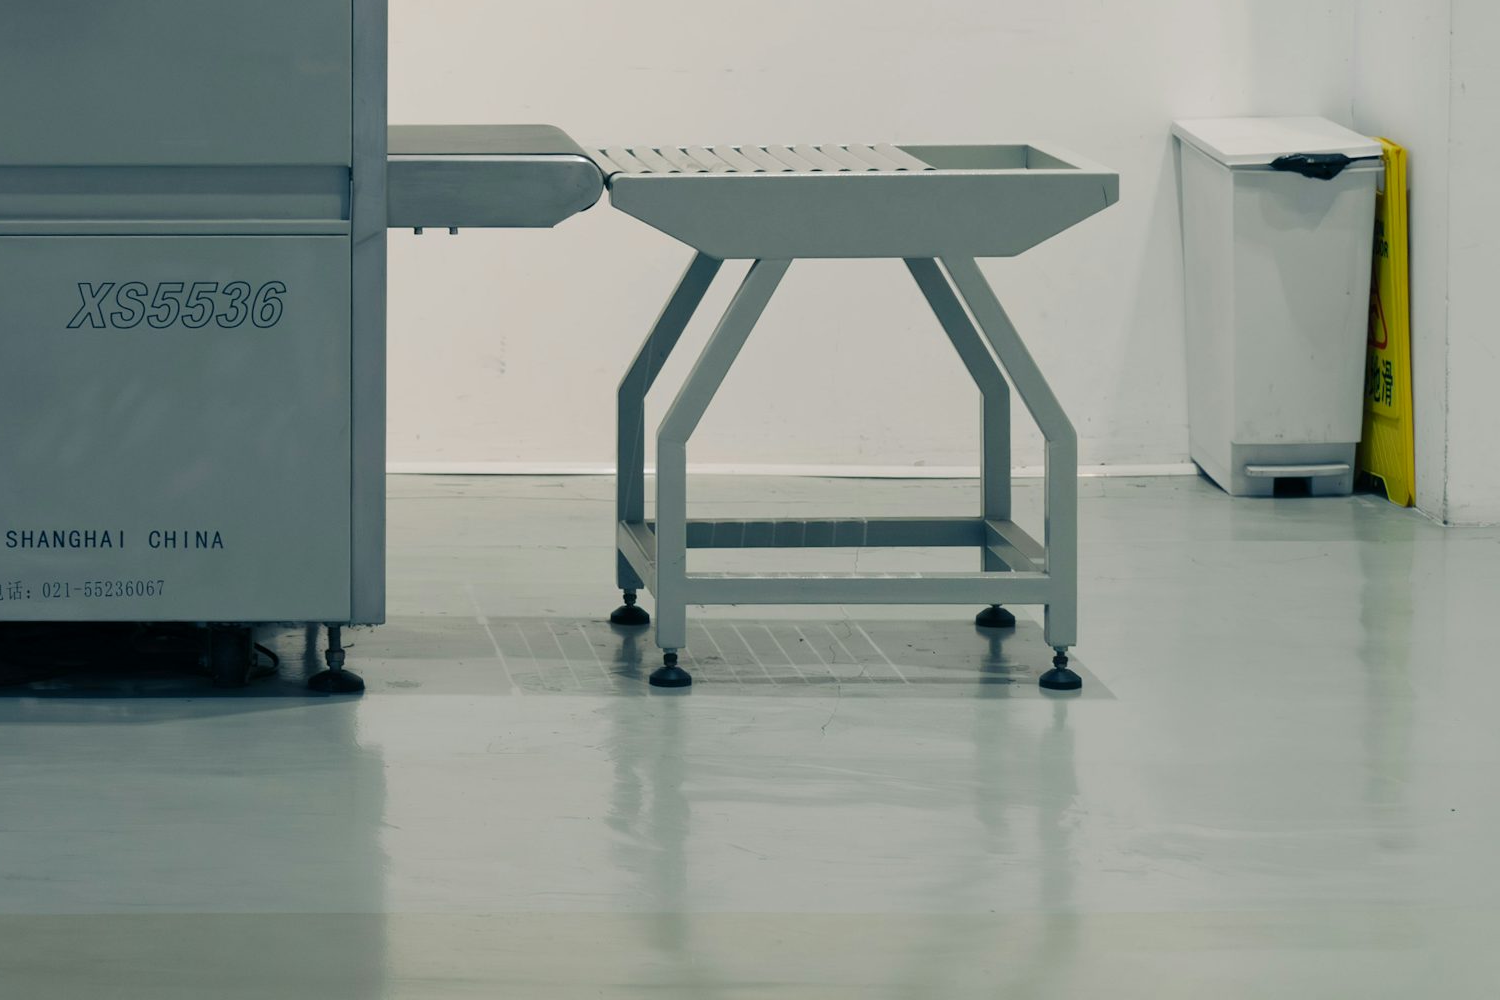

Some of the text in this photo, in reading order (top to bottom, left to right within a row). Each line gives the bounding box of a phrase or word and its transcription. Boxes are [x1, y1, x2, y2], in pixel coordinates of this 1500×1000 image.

[66, 280, 287, 329] XS5536
[5, 530, 126, 549] SHANGHAI
[148, 530, 224, 549] CHINA
